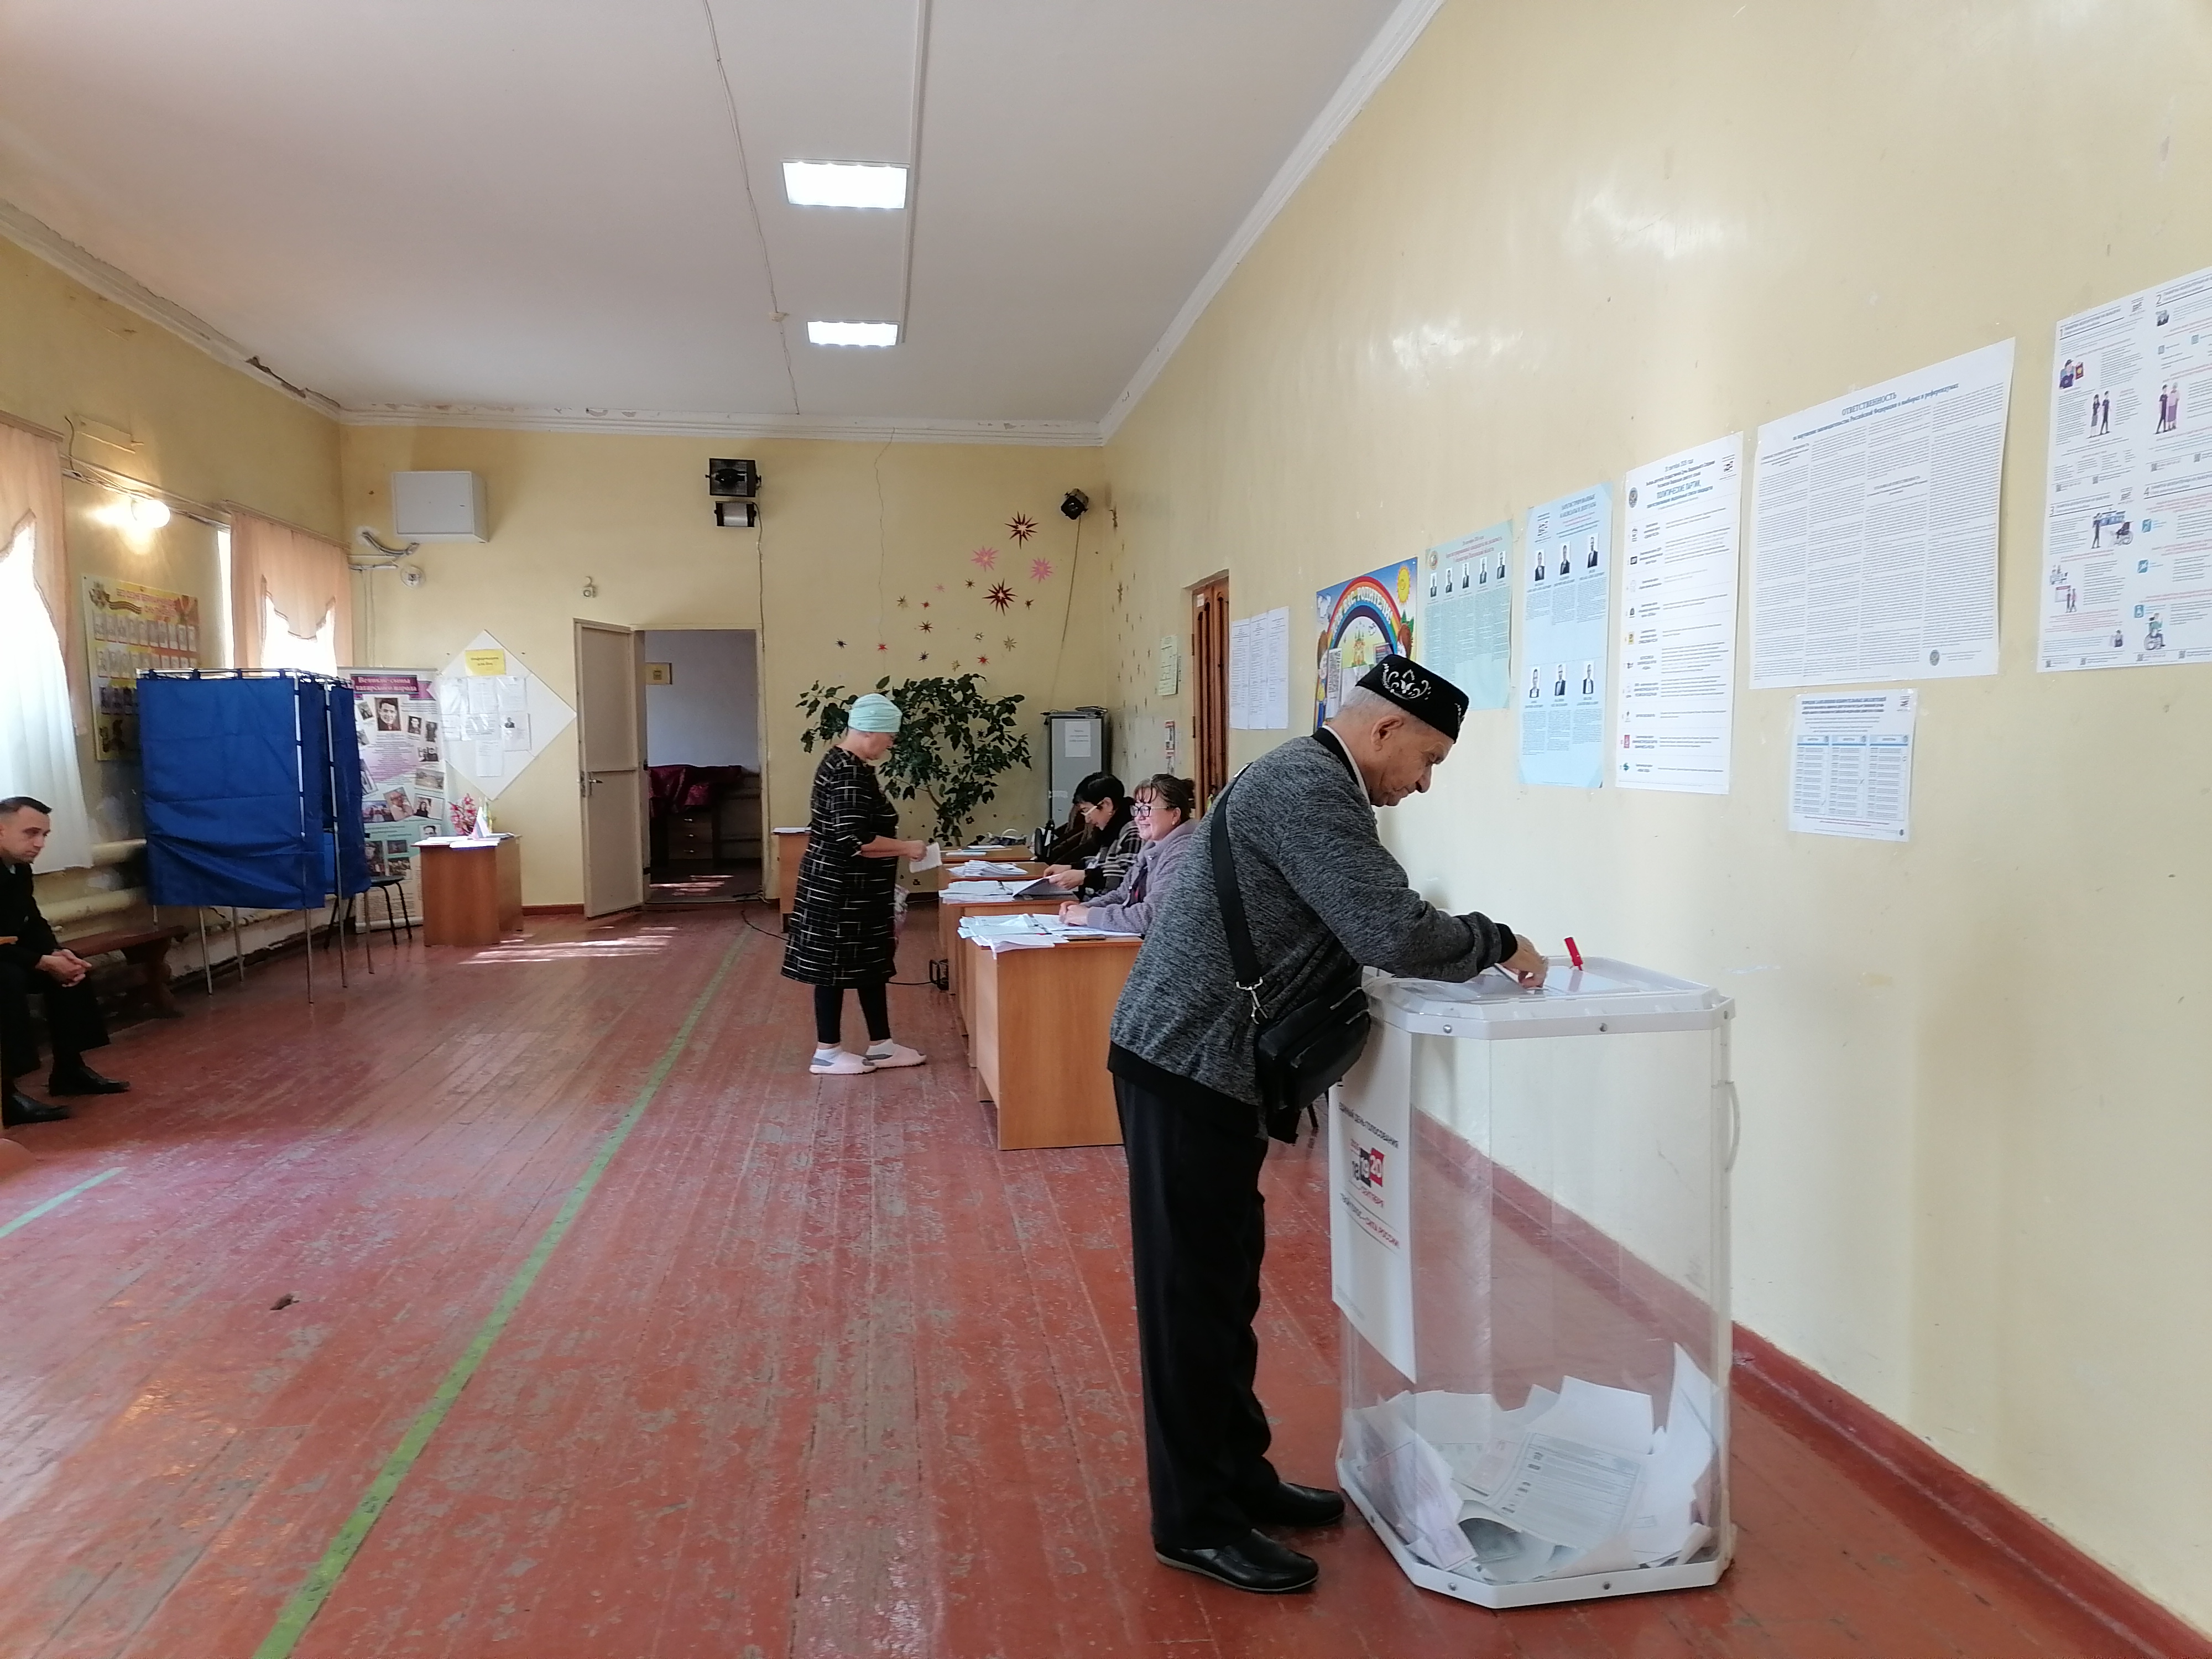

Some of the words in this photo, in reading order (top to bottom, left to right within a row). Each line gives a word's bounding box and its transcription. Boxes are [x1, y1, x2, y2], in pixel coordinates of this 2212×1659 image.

[1841, 392, 1897, 415] ОТВЕТСТВЕННОСТЬ
[1361, 1156, 1370, 1178] 19
[1370, 1155, 1383, 1178] 20
